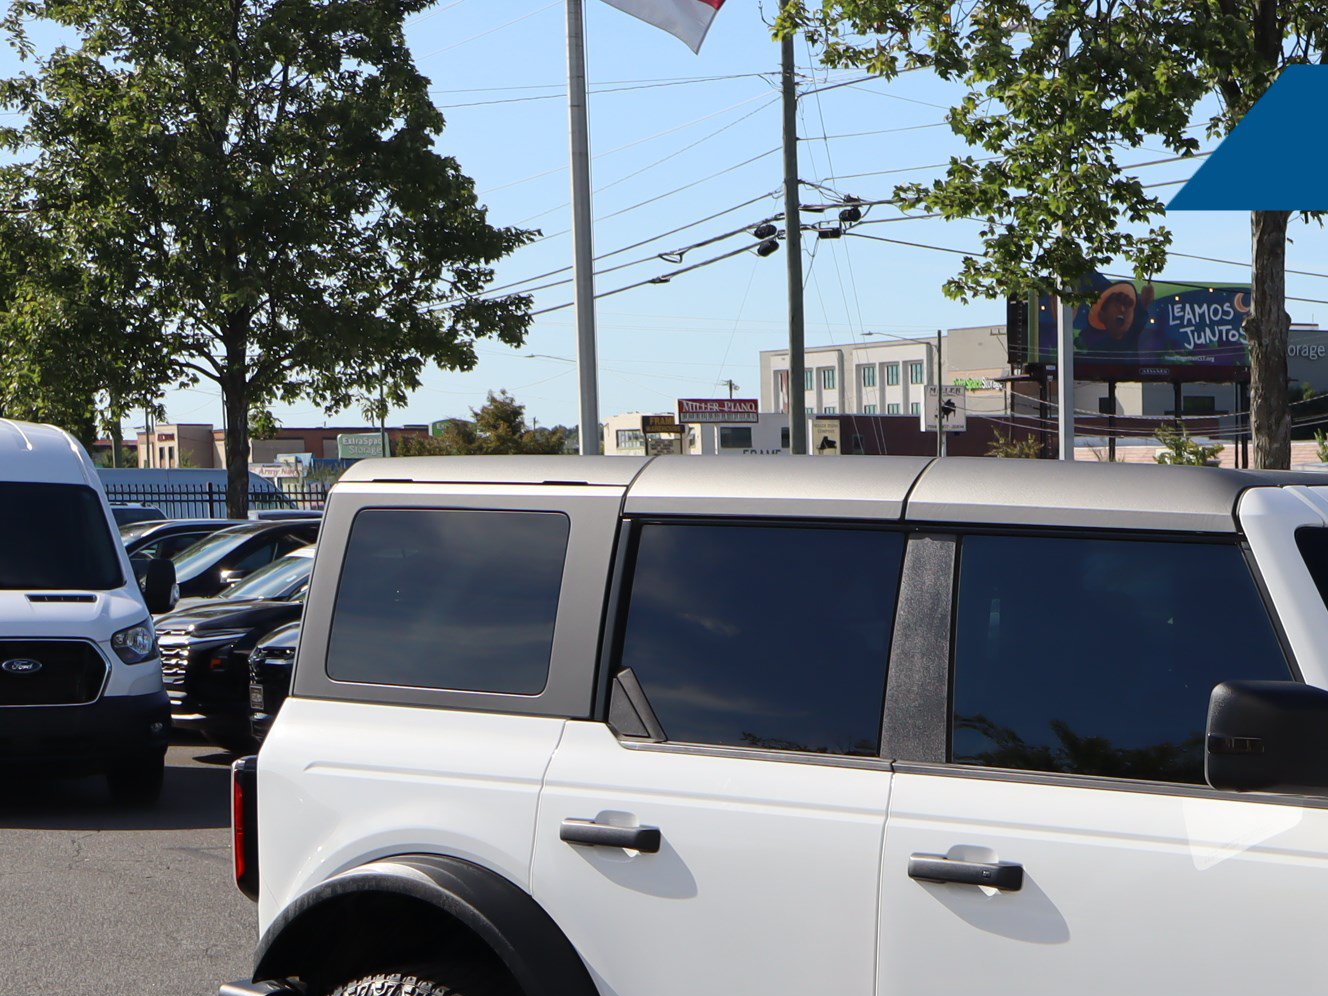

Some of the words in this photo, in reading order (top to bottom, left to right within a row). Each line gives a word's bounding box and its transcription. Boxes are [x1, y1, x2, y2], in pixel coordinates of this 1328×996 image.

[1169, 302, 1234, 326] LEAMOS
[1287, 344, 1327, 360] orage
[682, 400, 720, 412] MILLER
[724, 401, 757, 413] PIANO
[342, 436, 382, 446] ExtraSpac
